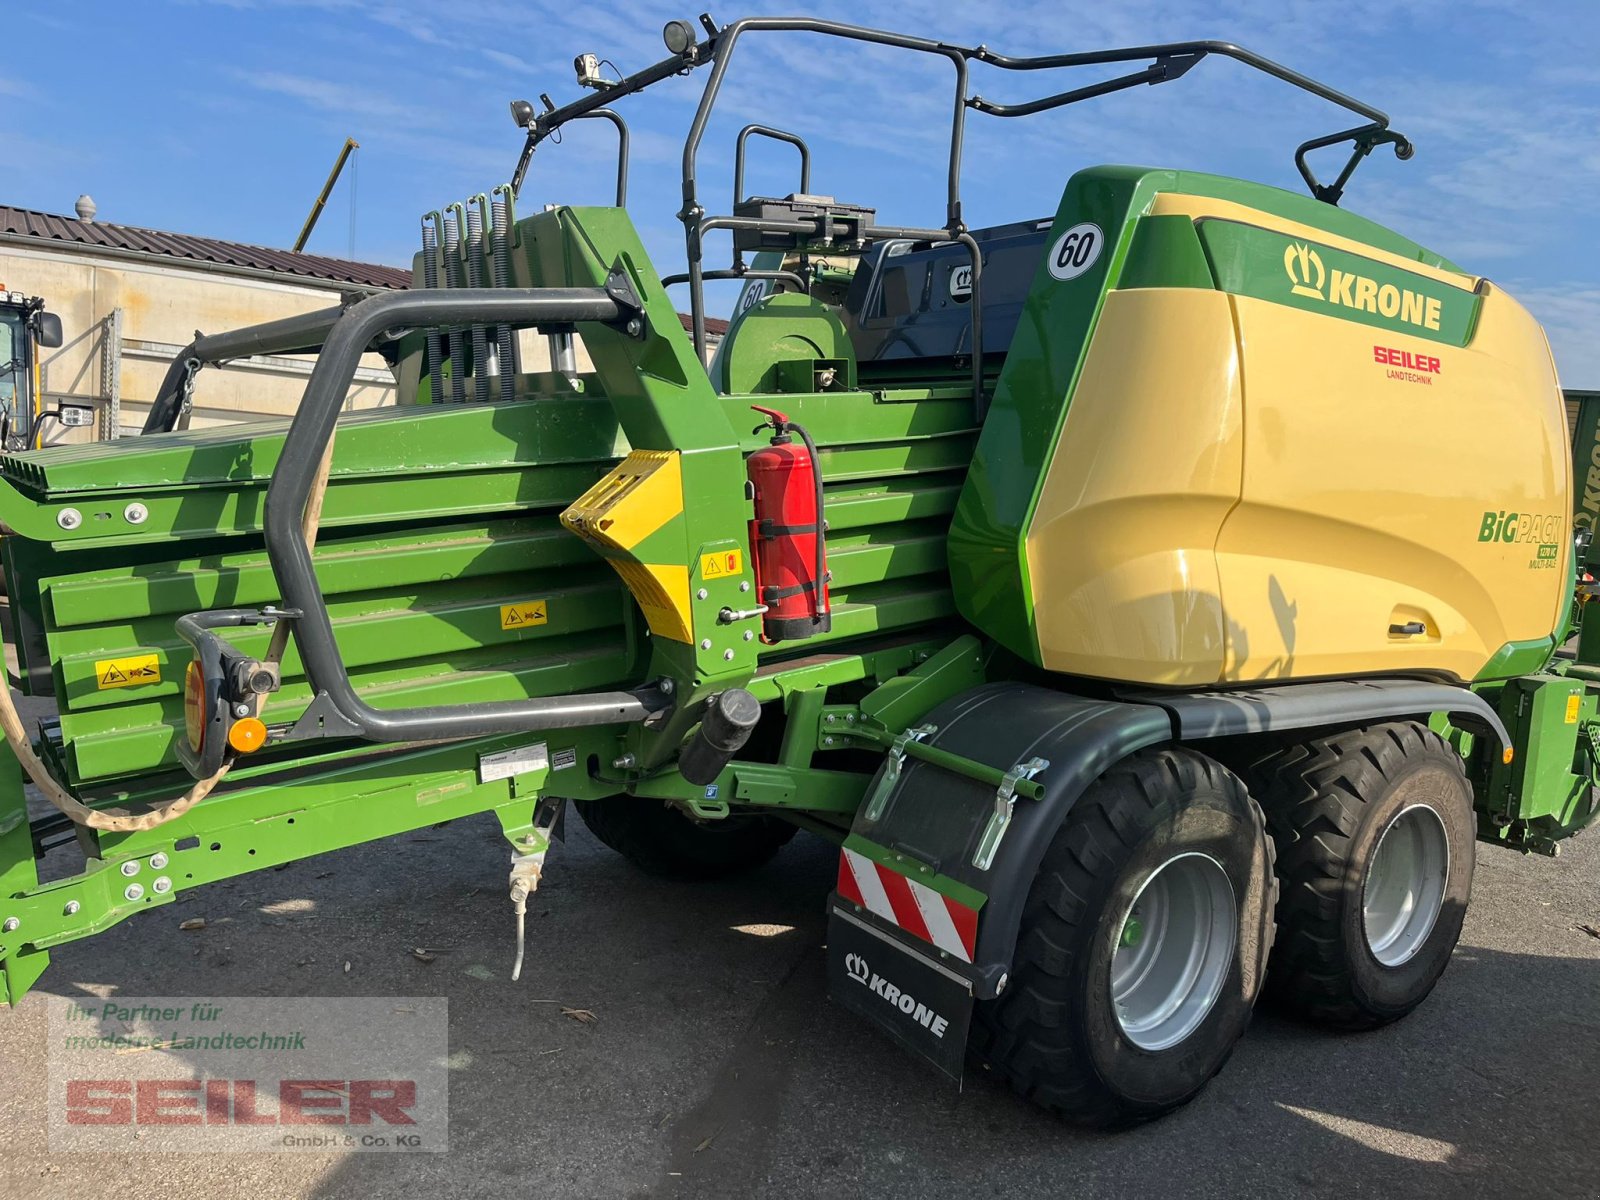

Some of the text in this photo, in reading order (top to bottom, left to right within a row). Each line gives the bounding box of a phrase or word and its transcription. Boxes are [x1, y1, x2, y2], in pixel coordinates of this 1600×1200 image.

[1057, 232, 1095, 268] 60
[743, 282, 763, 311] 60
[1329, 269, 1442, 331] KRONE
[1374, 345, 1441, 374] SEILER
[1387, 369, 1432, 385] LANDTECHNIK
[869, 973, 949, 1038] KRONE
